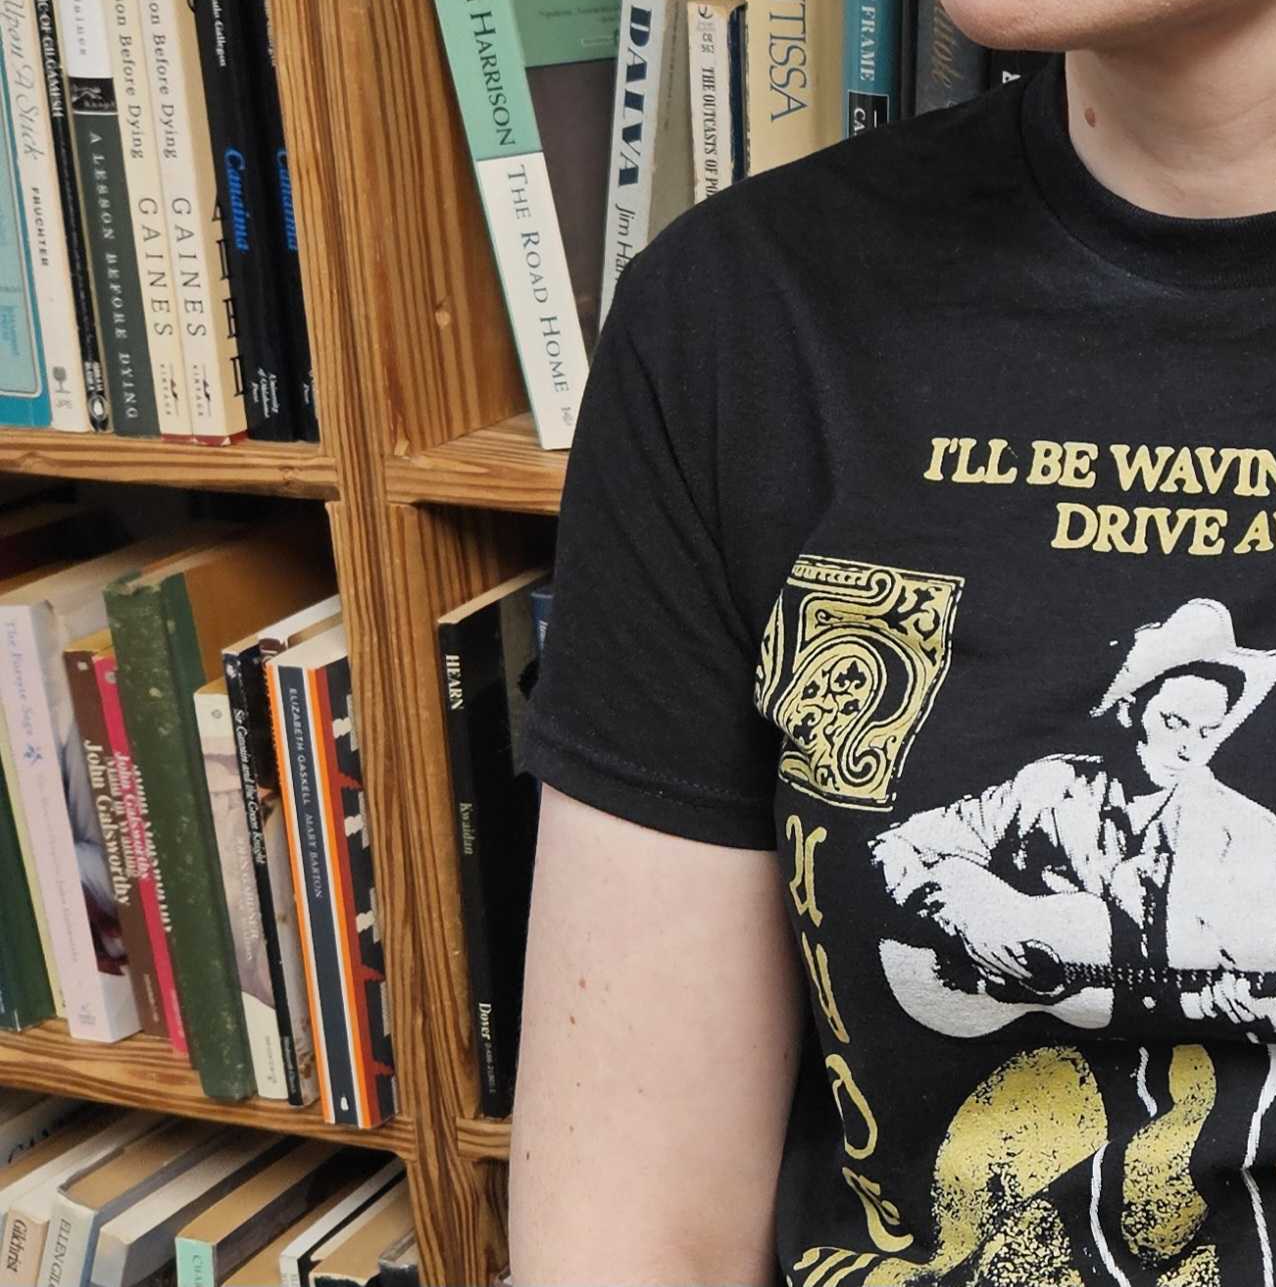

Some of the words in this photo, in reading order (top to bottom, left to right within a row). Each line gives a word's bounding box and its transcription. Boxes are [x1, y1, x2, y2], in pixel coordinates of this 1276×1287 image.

[39, 13, 52, 31] OF
[860, 5, 876, 81] FRAME
[41, 35, 64, 118] GILGAMESH
[118, 35, 138, 96] Before
[151, 34, 172, 95] Before
[470, 10, 516, 146] HARRISON
[89, 131, 102, 143] A
[125, 105, 148, 159] Dying
[157, 104, 181, 159] Dying
[93, 154, 116, 239] LESSON
[223, 146, 251, 252] Canaima
[105, 253, 129, 339] BEFORE
[137, 198, 173, 339] GAINES
[171, 198, 208, 339] GAINES
[505, 164, 531, 220] THE
[519, 231, 550, 305] ROAD
[538, 316, 570, 393] HOME
[117, 353, 140, 420] DYING
[924, 439, 1018, 484] I'LL
[1026, 441, 1099, 486] BE
[1050, 505, 1226, 554] DRIVE
[445, 655, 463, 711] HEARN
[289, 688, 303, 751] ELIZABETH
[297, 755, 310, 805] GASKELL
[83, 740, 107, 789] John
[95, 794, 131, 906] Galsworthy
[305, 813, 317, 848] MARY
[459, 803, 476, 855] Kwaidan
[309, 851, 323, 898] BARTON
[477, 1002, 493, 1040] Dover
[7, 1219, 28, 1273] Gilchrist
